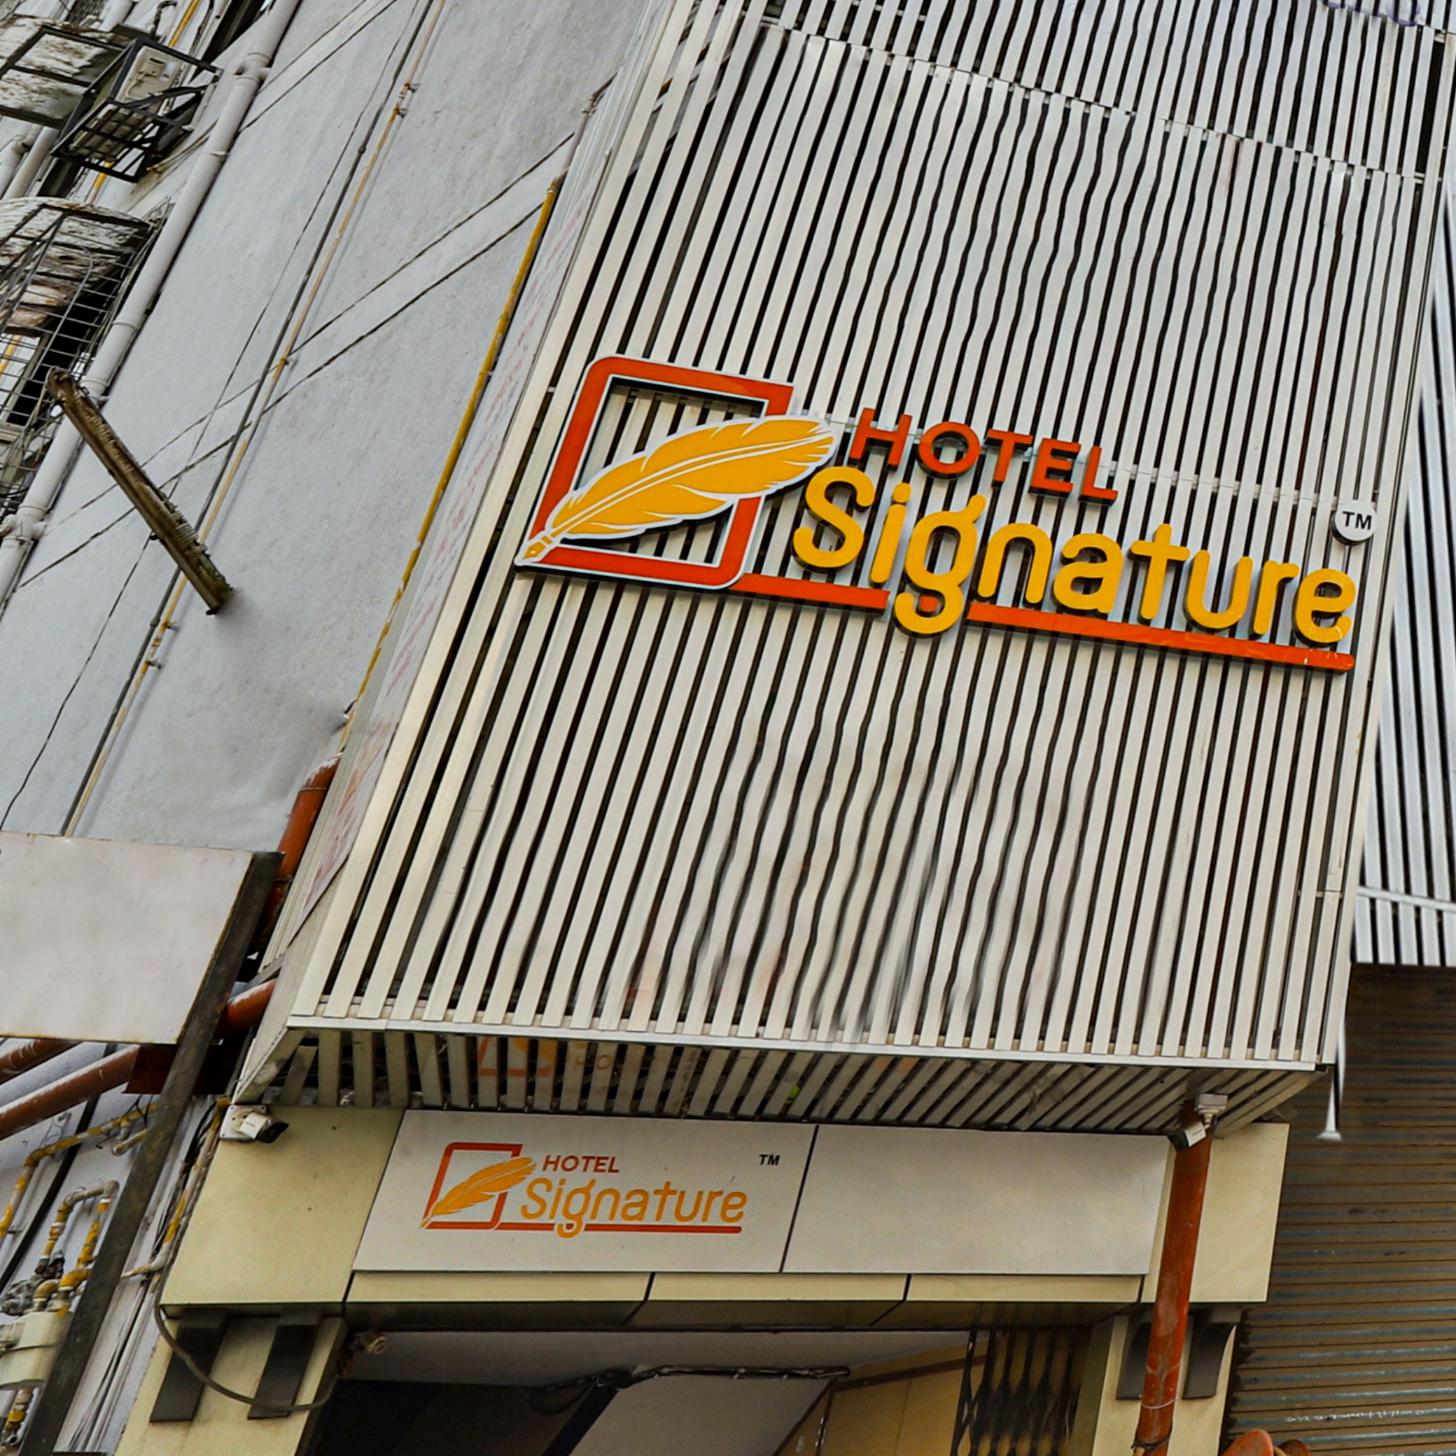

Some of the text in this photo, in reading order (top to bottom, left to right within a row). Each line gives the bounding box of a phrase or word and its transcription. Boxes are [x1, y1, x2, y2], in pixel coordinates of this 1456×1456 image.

[849, 407, 1118, 504] HOTEL
[1342, 511, 1372, 531] TM
[793, 466, 1356, 644] Signature
[542, 1155, 619, 1173] HOTEL
[759, 1154, 780, 1166] TM
[520, 1177, 748, 1239] Signature
